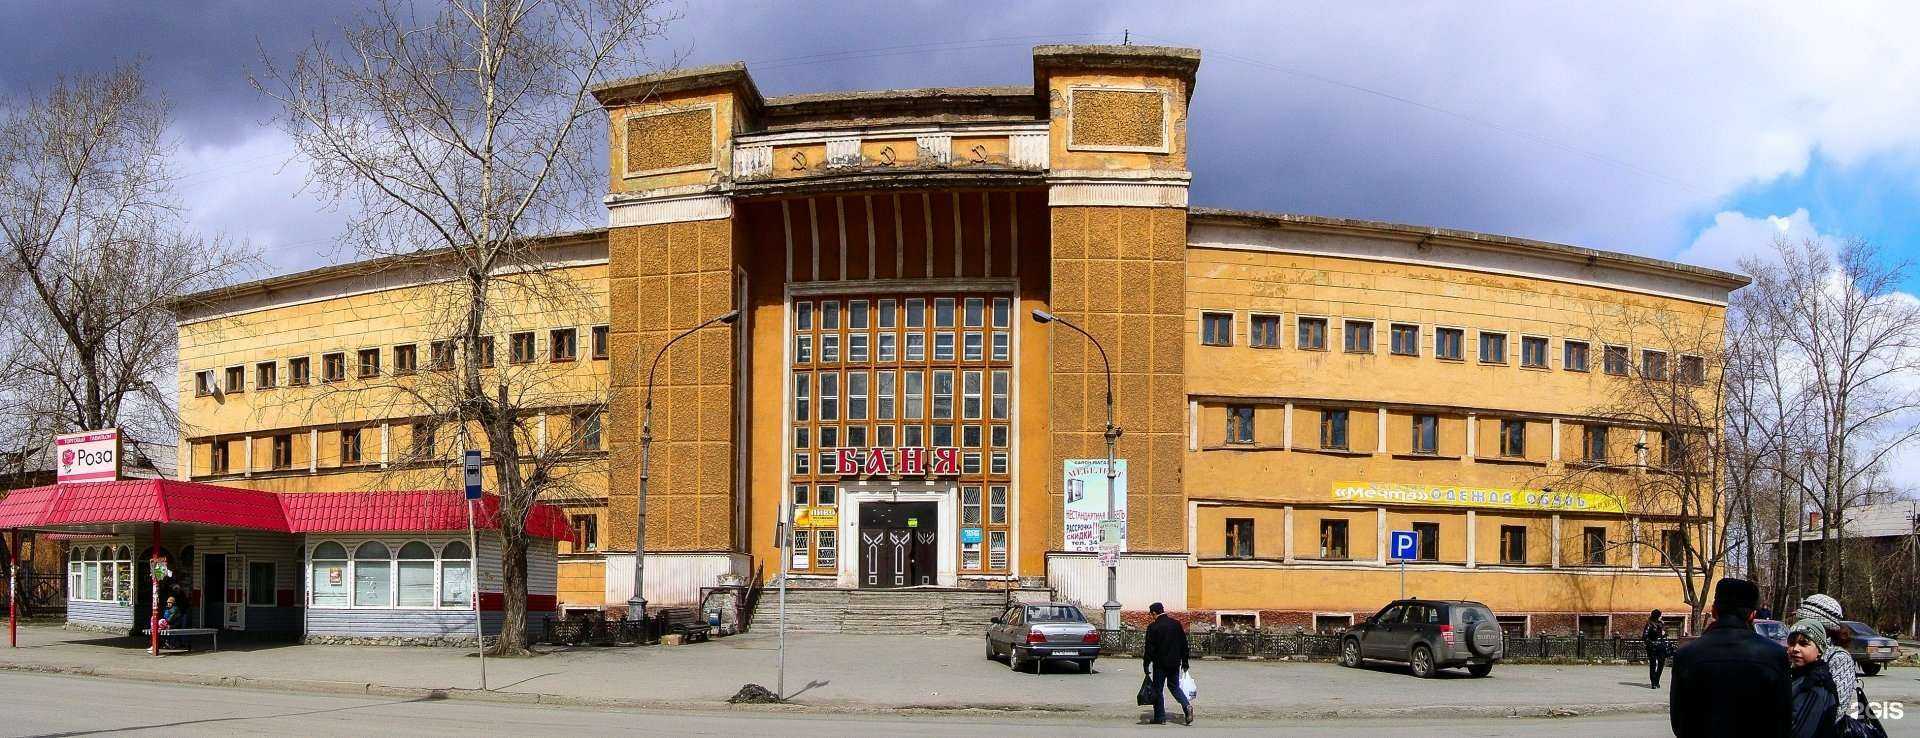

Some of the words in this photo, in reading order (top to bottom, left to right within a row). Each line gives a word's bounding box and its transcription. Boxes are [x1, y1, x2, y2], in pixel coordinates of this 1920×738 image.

[78, 449, 113, 466] Роза
[835, 446, 961, 476] БАНЯ
[1431, 487, 1511, 503] ОДЕЖДА
[1066, 523, 1092, 532] РАССРОЧКА
[1066, 531, 1092, 540] СКИДКИ
[1397, 534, 1413, 557] P
